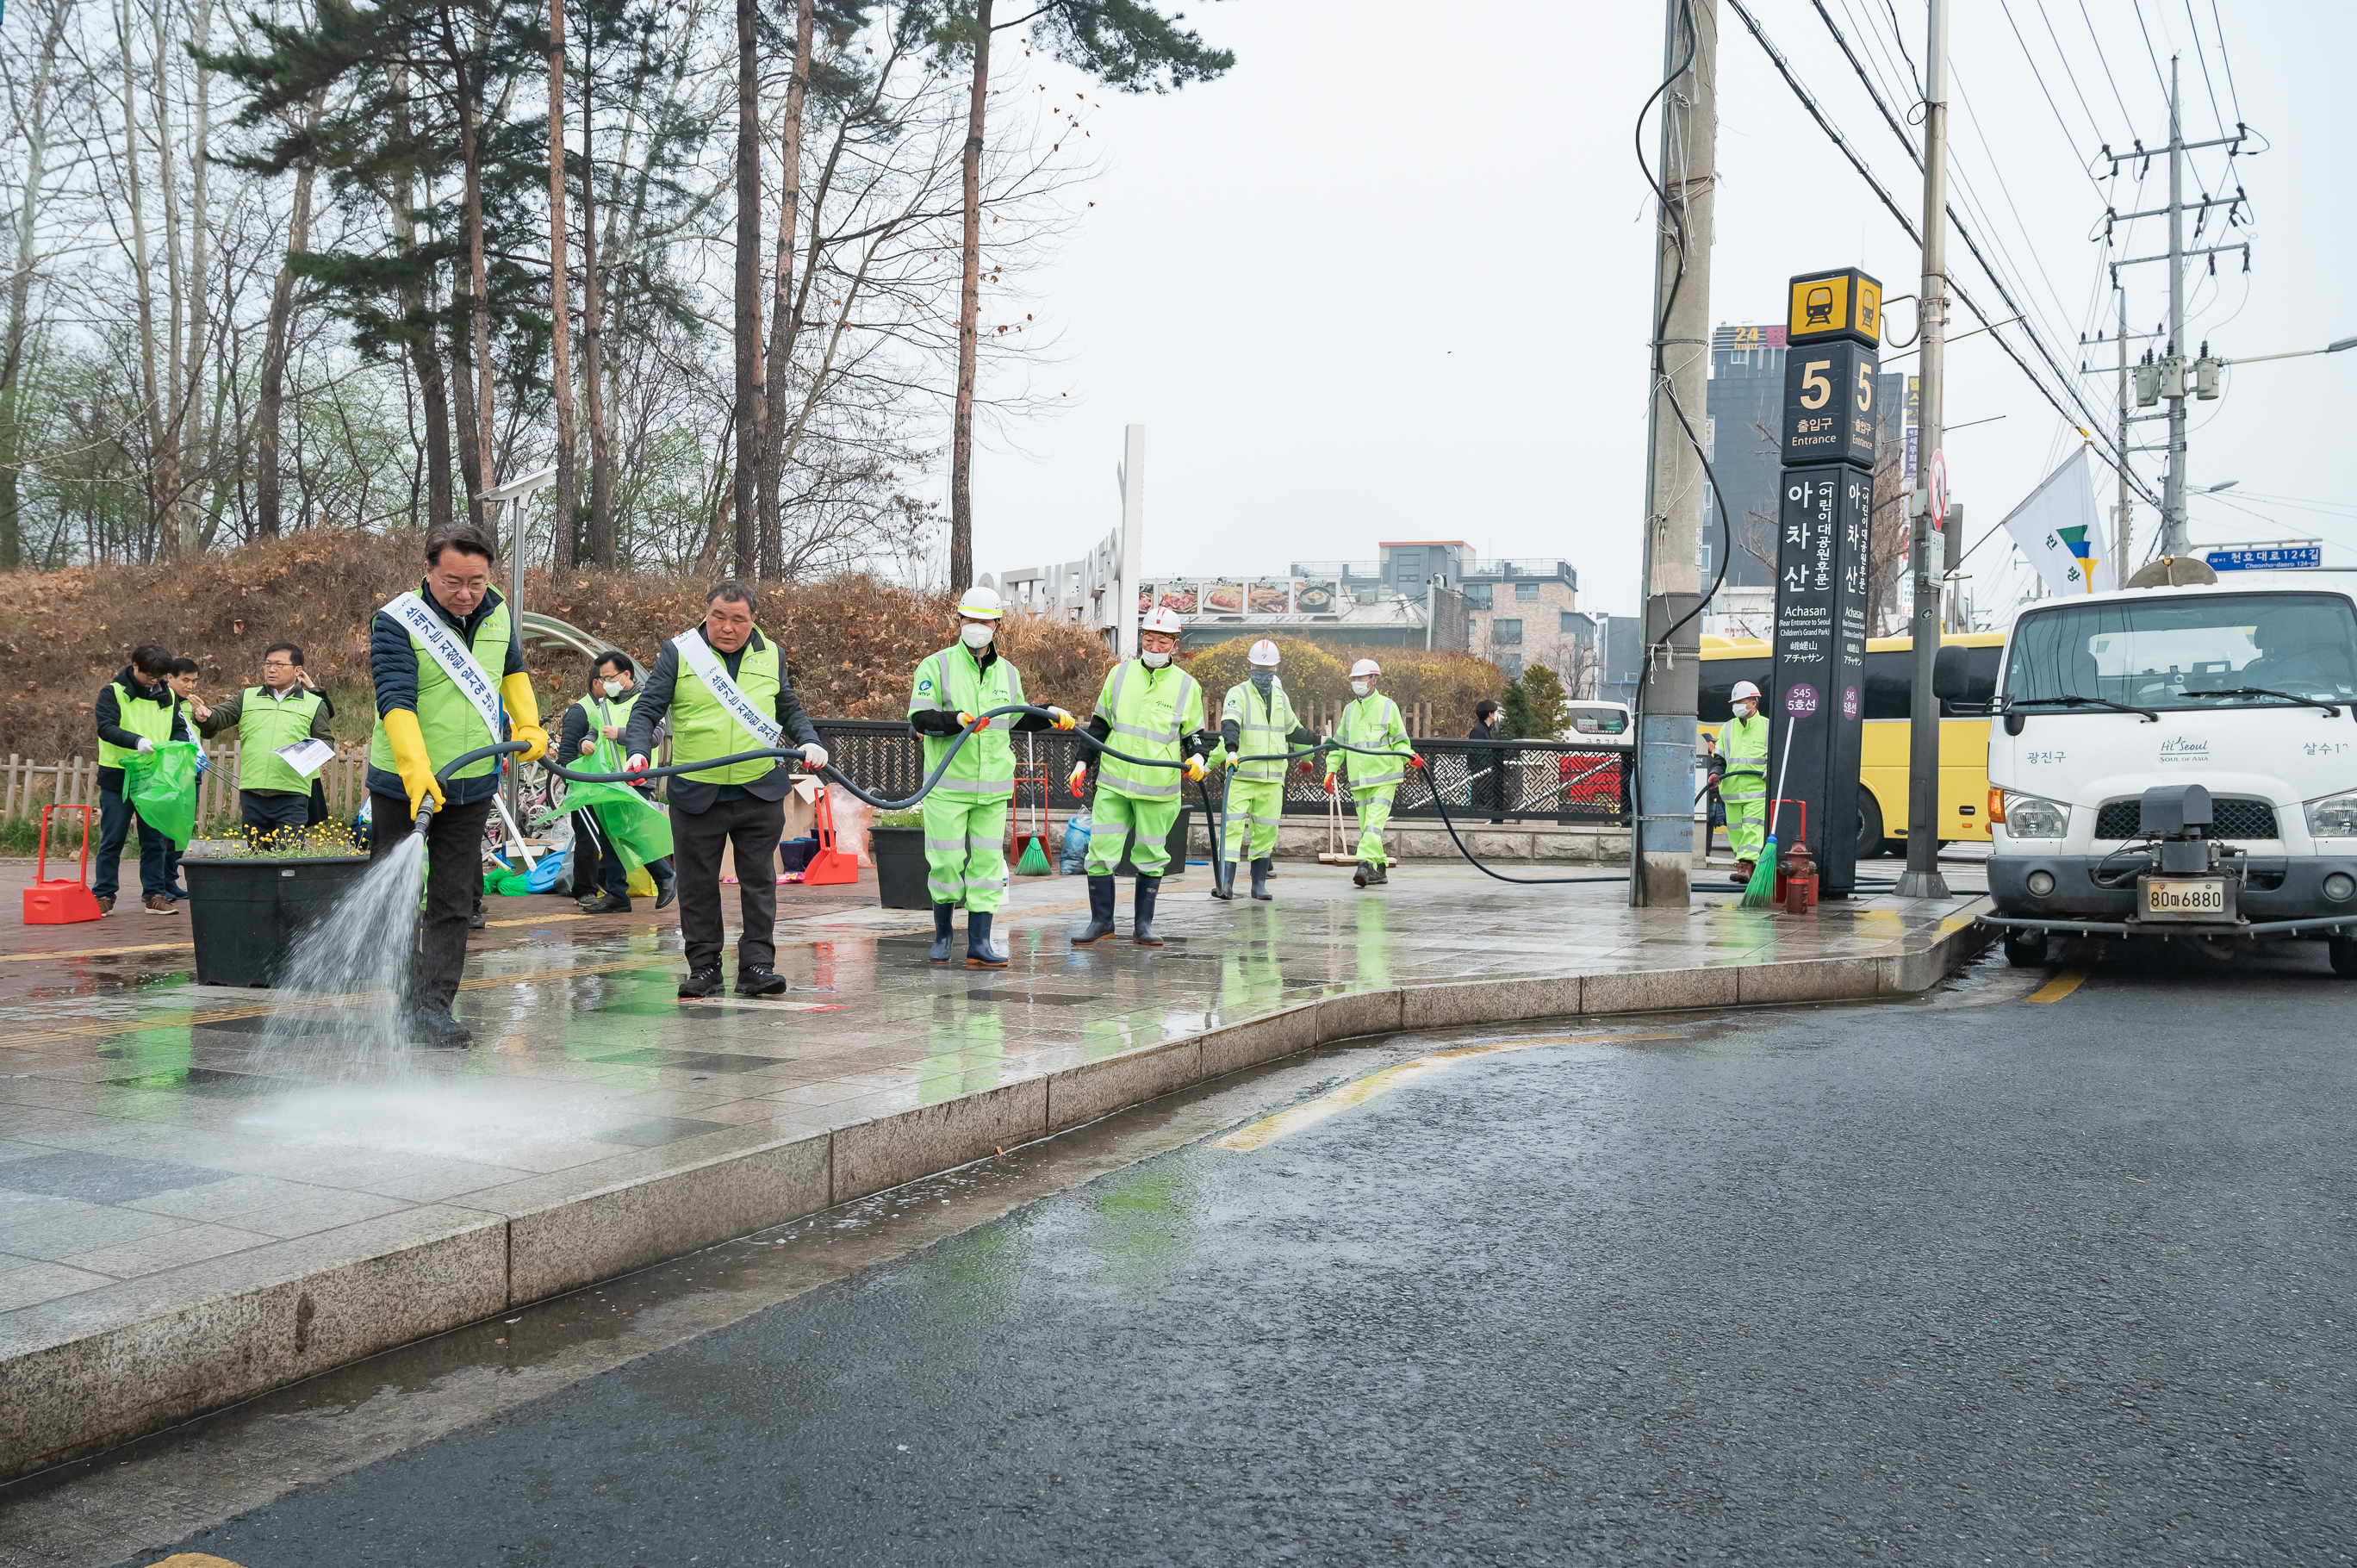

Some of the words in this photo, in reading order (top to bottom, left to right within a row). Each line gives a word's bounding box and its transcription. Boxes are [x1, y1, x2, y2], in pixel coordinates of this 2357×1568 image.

[1735, 327, 1759, 342] 24
[1800, 360, 1831, 410] 5
[1856, 362, 1873, 412] 5
[1797, 418, 1833, 433] 출입구
[1855, 419, 1872, 436] 출입구
[1792, 434, 1837, 446] Entrance
[1852, 434, 1873, 450] Entrance
[1784, 482, 1813, 592] 아차산
[1814, 482, 1835, 591] (어린이대공원후문)
[1845, 482, 1861, 594] 아차산
[2231, 549, 2319, 563] 천호대로124길
[1784, 606, 1826, 617] Achasan
[1844, 607, 1864, 619] Achasan
[406, 606, 444, 644] 쓰레기는
[438, 639, 466, 669] 지정된
[461, 667, 487, 695] 일시에
[1783, 653, 1825, 663] アチャサン
[1844, 656, 1863, 666] アチャサン
[712, 675, 740, 706] 쓰레기는
[736, 703, 762, 726] 지정된
[1793, 689, 1811, 698] 545
[1846, 691, 1855, 700] 545
[1788, 700, 1816, 711] 5호선
[1844, 702, 1856, 714] 5호선
[2179, 740, 2208, 751] Seoul
[2026, 751, 2067, 765] 광진구
[2150, 891, 2221, 909] 80마6880
